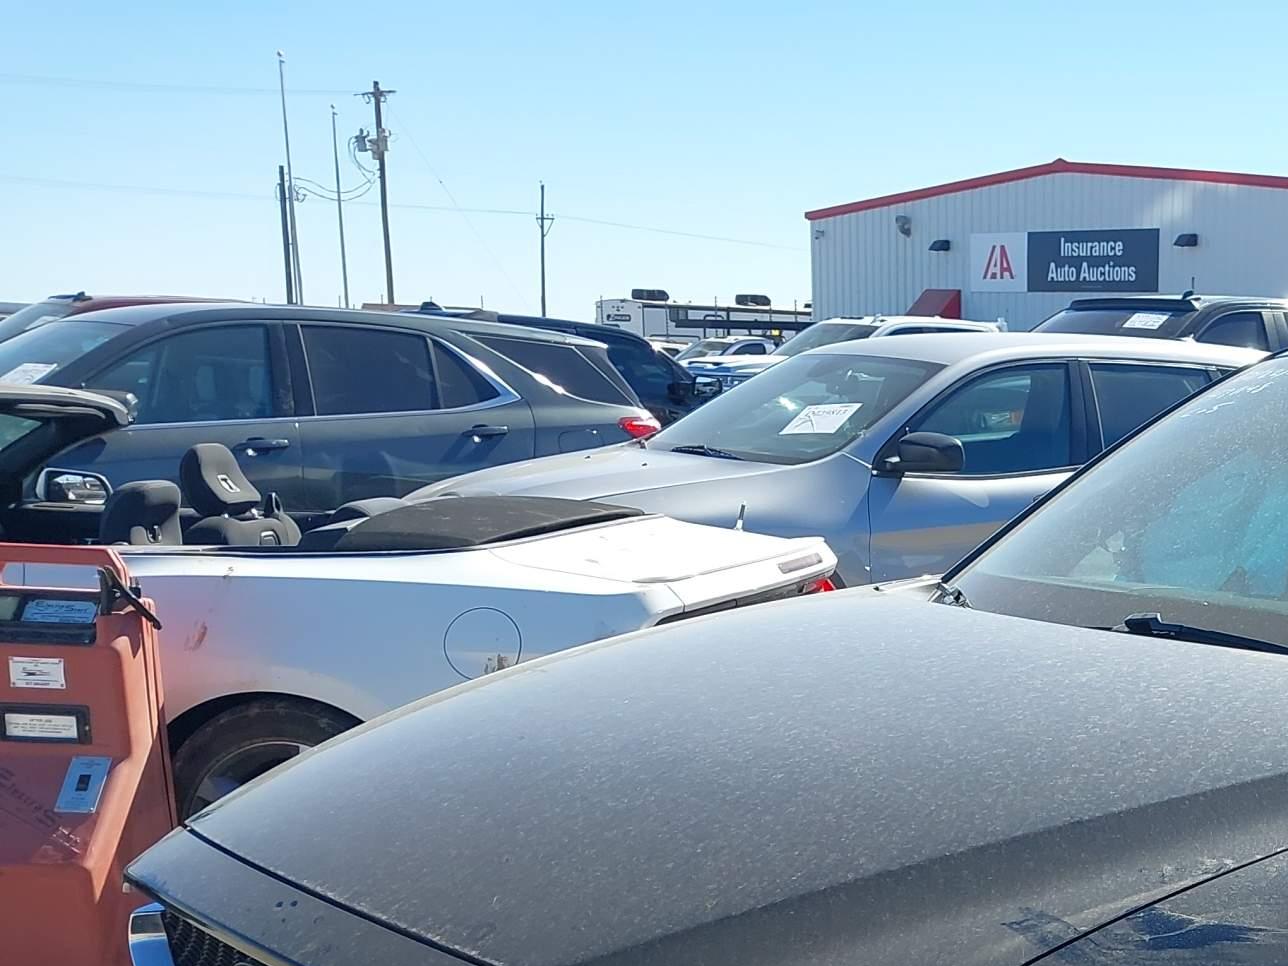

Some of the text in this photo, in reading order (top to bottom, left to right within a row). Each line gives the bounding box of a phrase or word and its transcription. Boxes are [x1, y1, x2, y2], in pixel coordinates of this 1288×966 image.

[1060, 237, 1123, 257] Insurance
[1047, 261, 1136, 282] Auto Auctions
